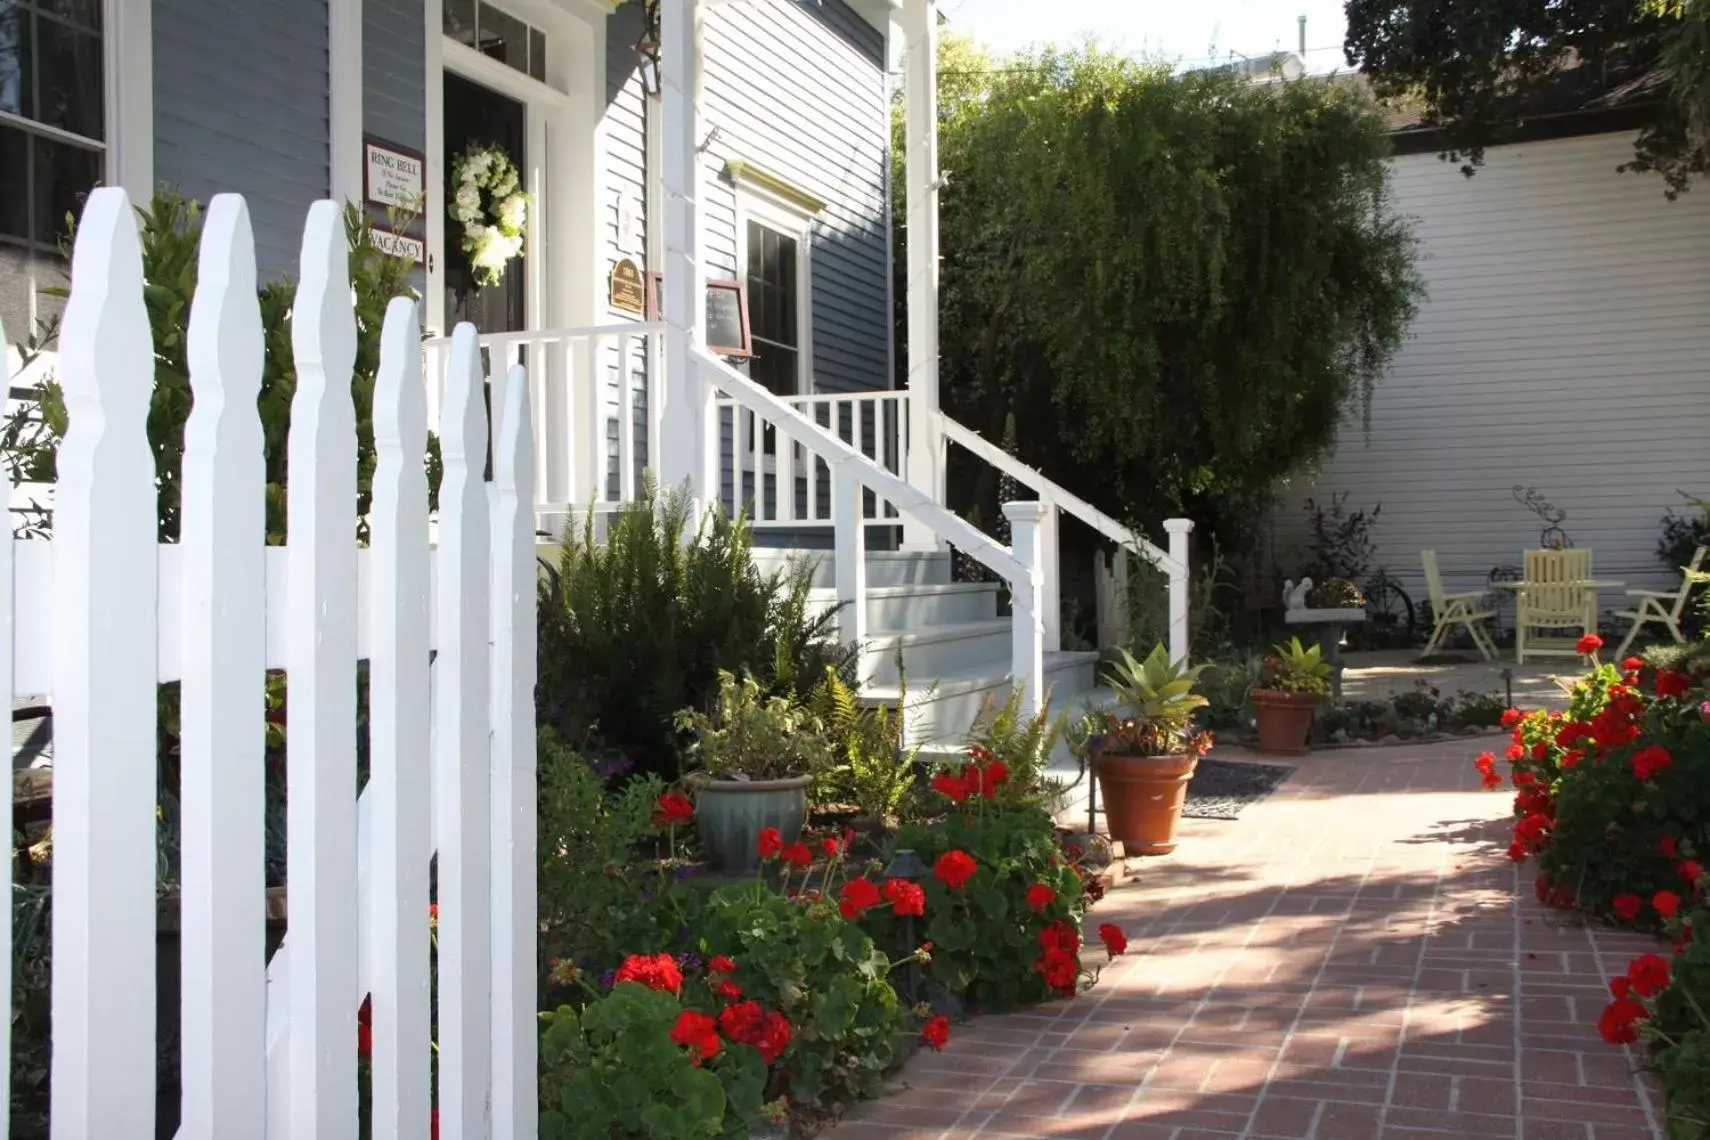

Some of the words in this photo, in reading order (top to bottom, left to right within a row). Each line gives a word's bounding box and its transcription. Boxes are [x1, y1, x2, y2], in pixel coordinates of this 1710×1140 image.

[371, 151, 394, 168] RING
[396, 158, 418, 176] BELL
[371, 234, 420, 256] VACANCY
